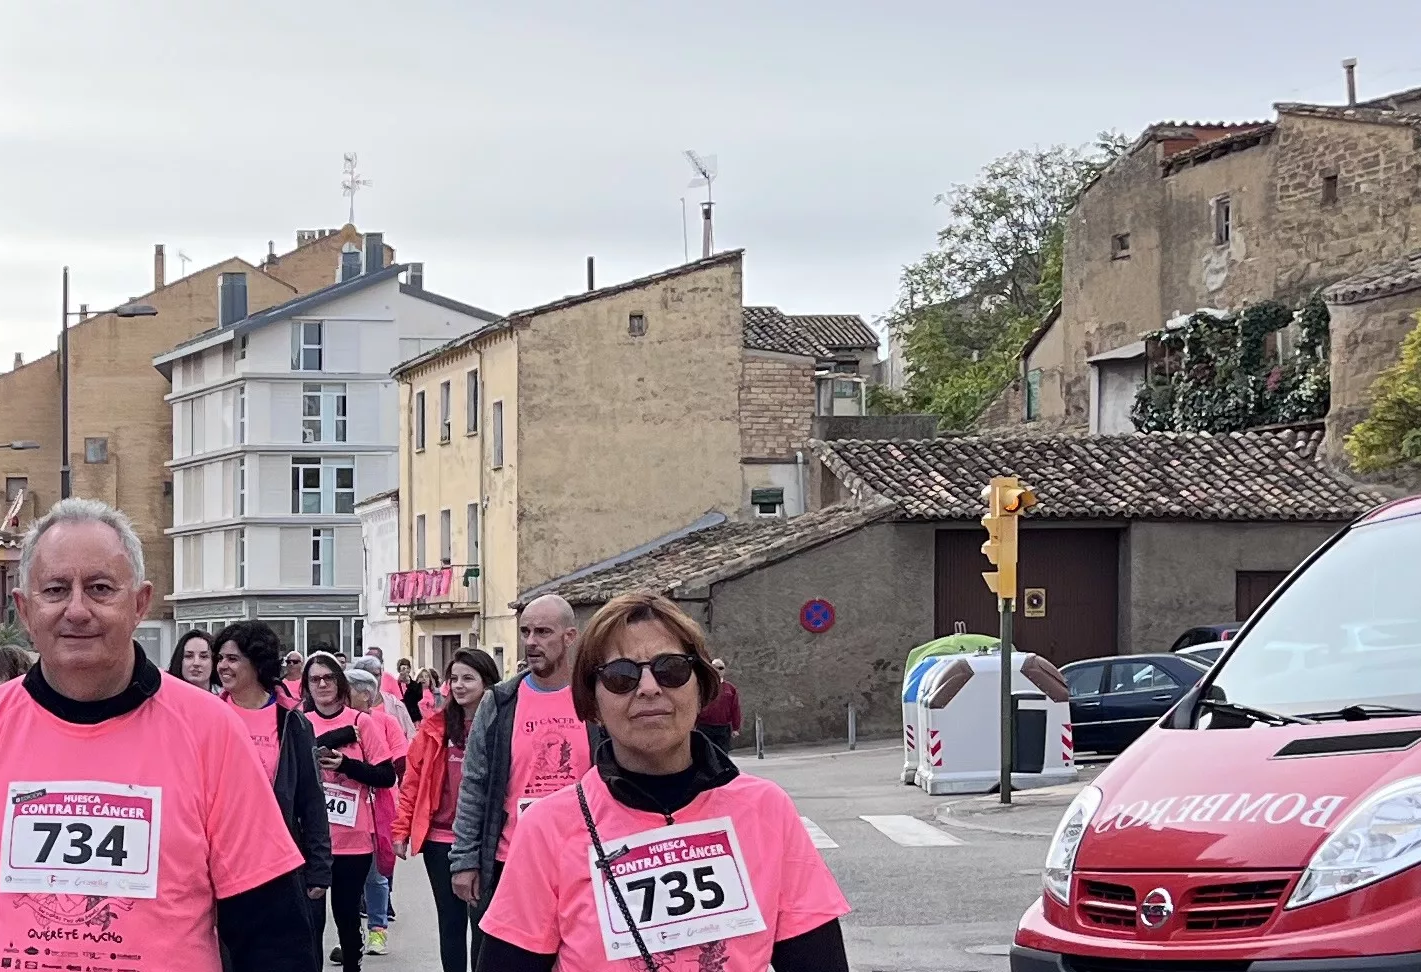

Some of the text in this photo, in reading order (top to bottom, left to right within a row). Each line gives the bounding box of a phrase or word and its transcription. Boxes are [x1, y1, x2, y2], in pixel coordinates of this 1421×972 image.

[63, 794, 101, 804] HUESCA
[20, 803, 145, 819] CONTRA EL CÁNCER
[33, 821, 128, 867] 734
[648, 839, 687, 854] HUESCA
[663, 852, 680, 863] EL
[681, 843, 726, 860] CÁNCER
[626, 865, 726, 923] 735
[27, 926, 123, 943] QUIÉRETE MUCHO
